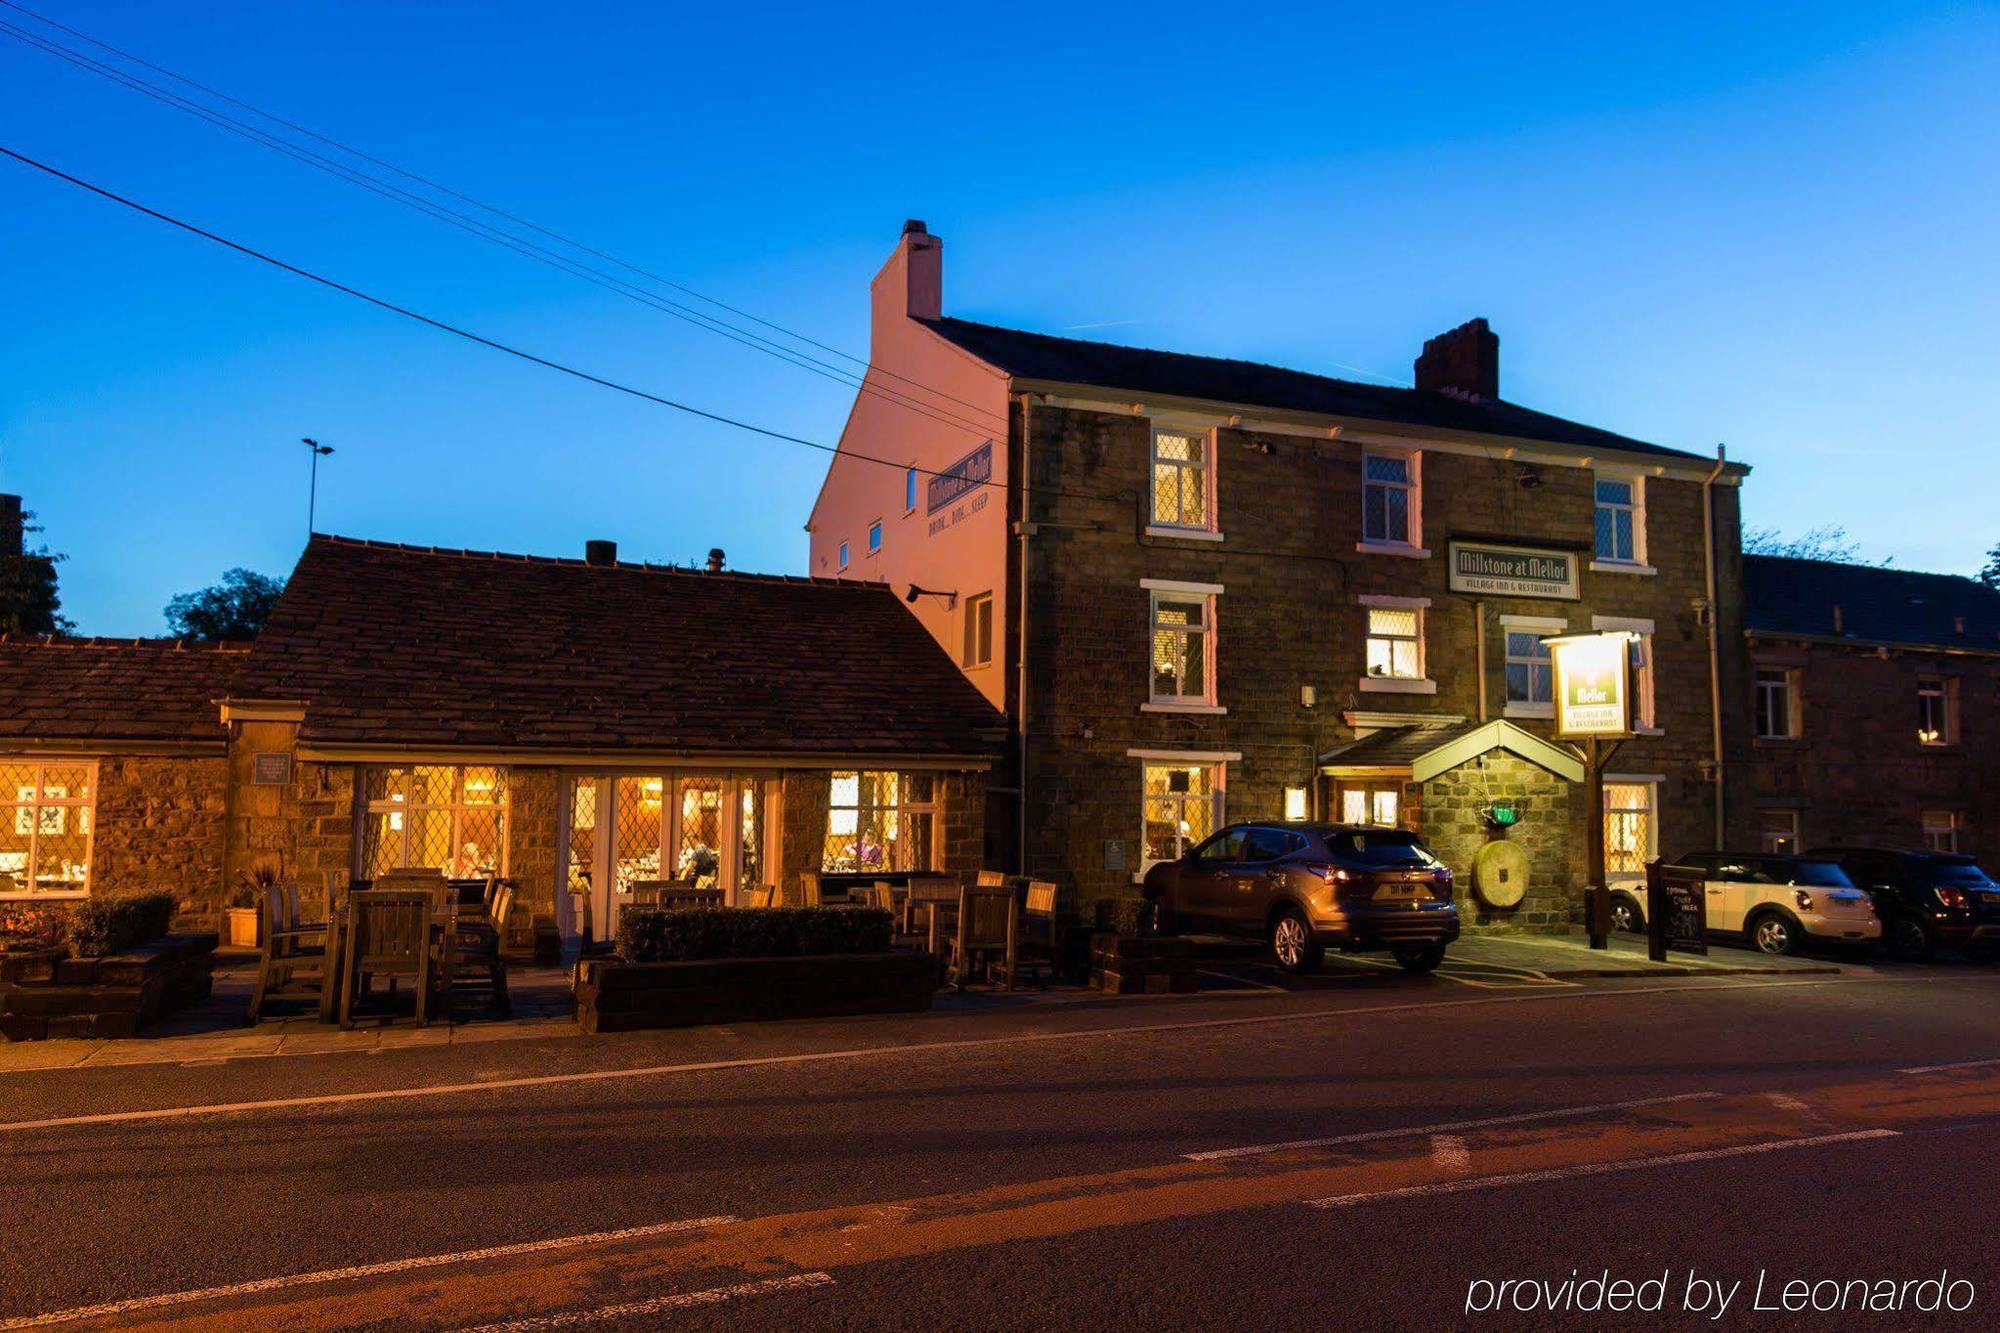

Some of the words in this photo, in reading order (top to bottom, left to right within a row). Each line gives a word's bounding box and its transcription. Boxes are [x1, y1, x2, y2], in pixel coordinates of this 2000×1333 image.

[1460, 551, 1512, 576] Millstone
[1515, 561, 1527, 577] at
[1529, 558, 1566, 580] Mellor
[1466, 579, 1494, 591] VILLAGE
[1518, 583, 1562, 594] RESTAURANT
[1577, 688, 1607, 704] Mellor
